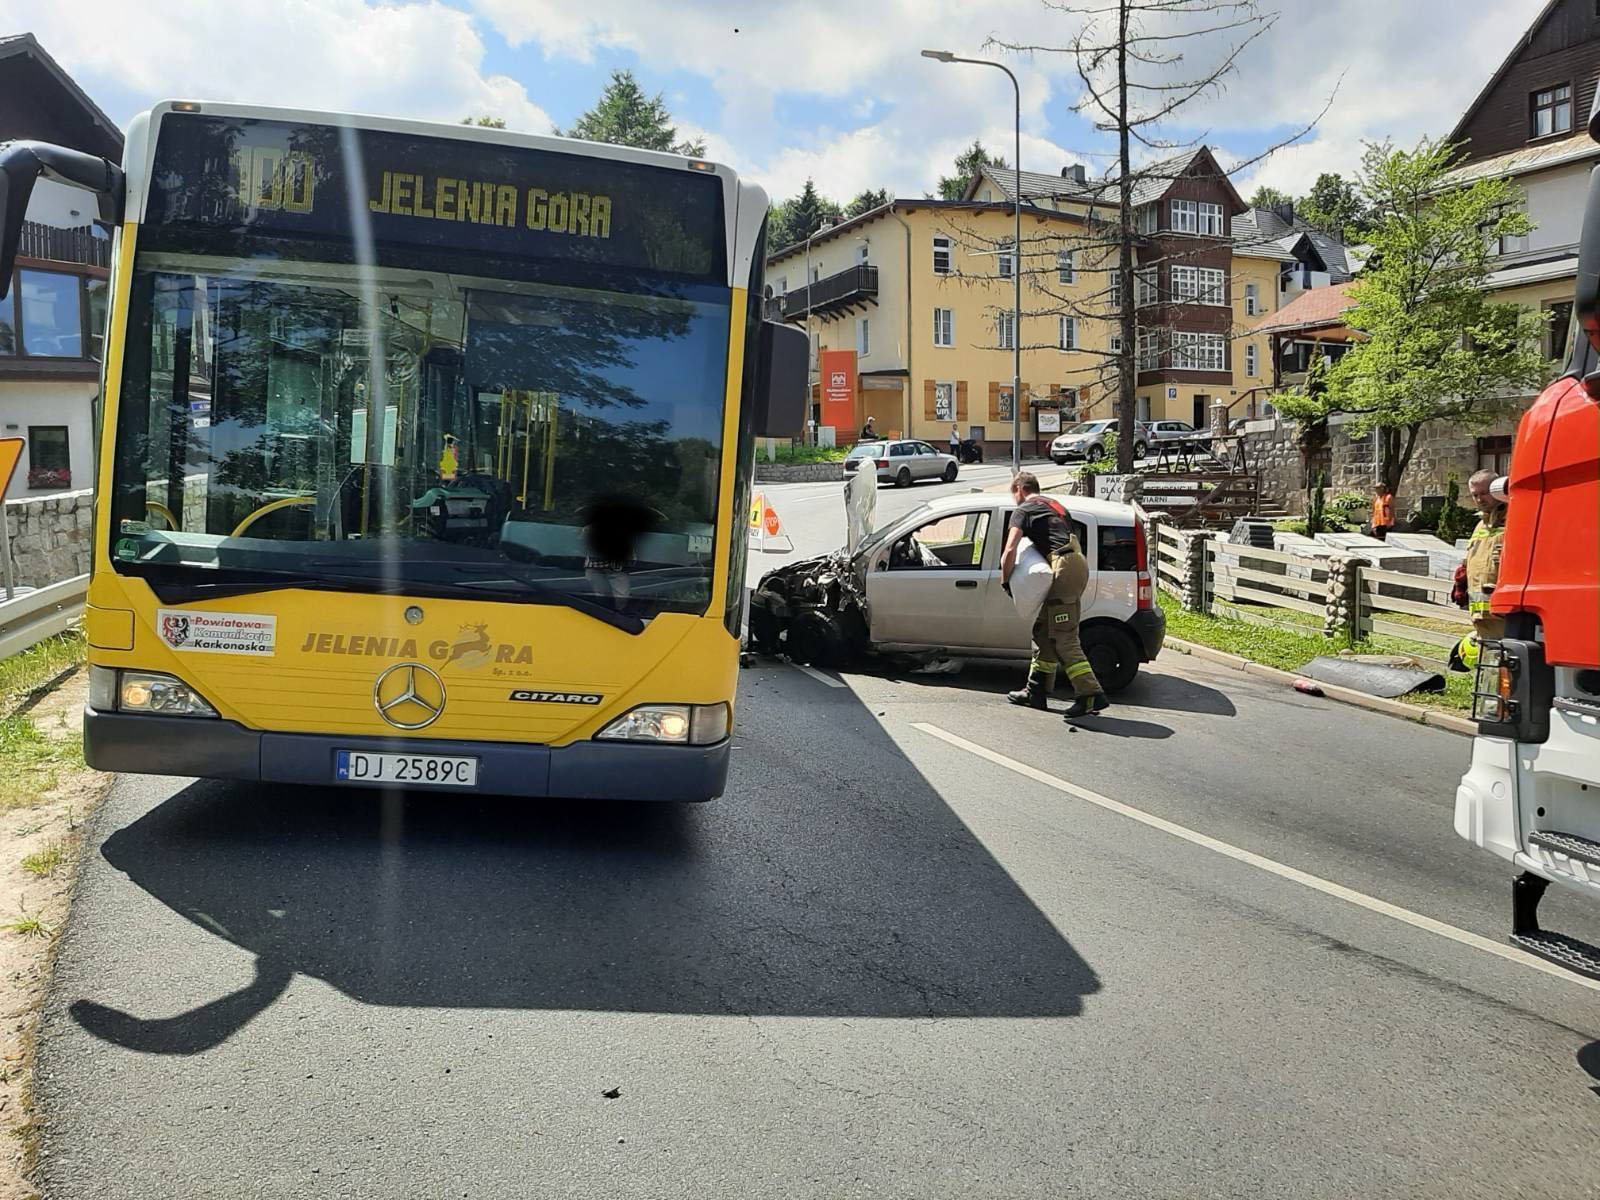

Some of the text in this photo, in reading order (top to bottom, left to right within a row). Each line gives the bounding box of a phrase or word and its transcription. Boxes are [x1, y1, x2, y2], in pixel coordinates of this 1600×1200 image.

[369, 171, 518, 228] JELENIA
[195, 616, 262, 629] Powiatowa
[194, 627, 272, 643] Komunikacja
[194, 639, 266, 652] Karkonoska
[301, 632, 534, 665] JELENIA GRA
[514, 691, 600, 704] CITARO
[354, 755, 470, 782] DJ 2589C
